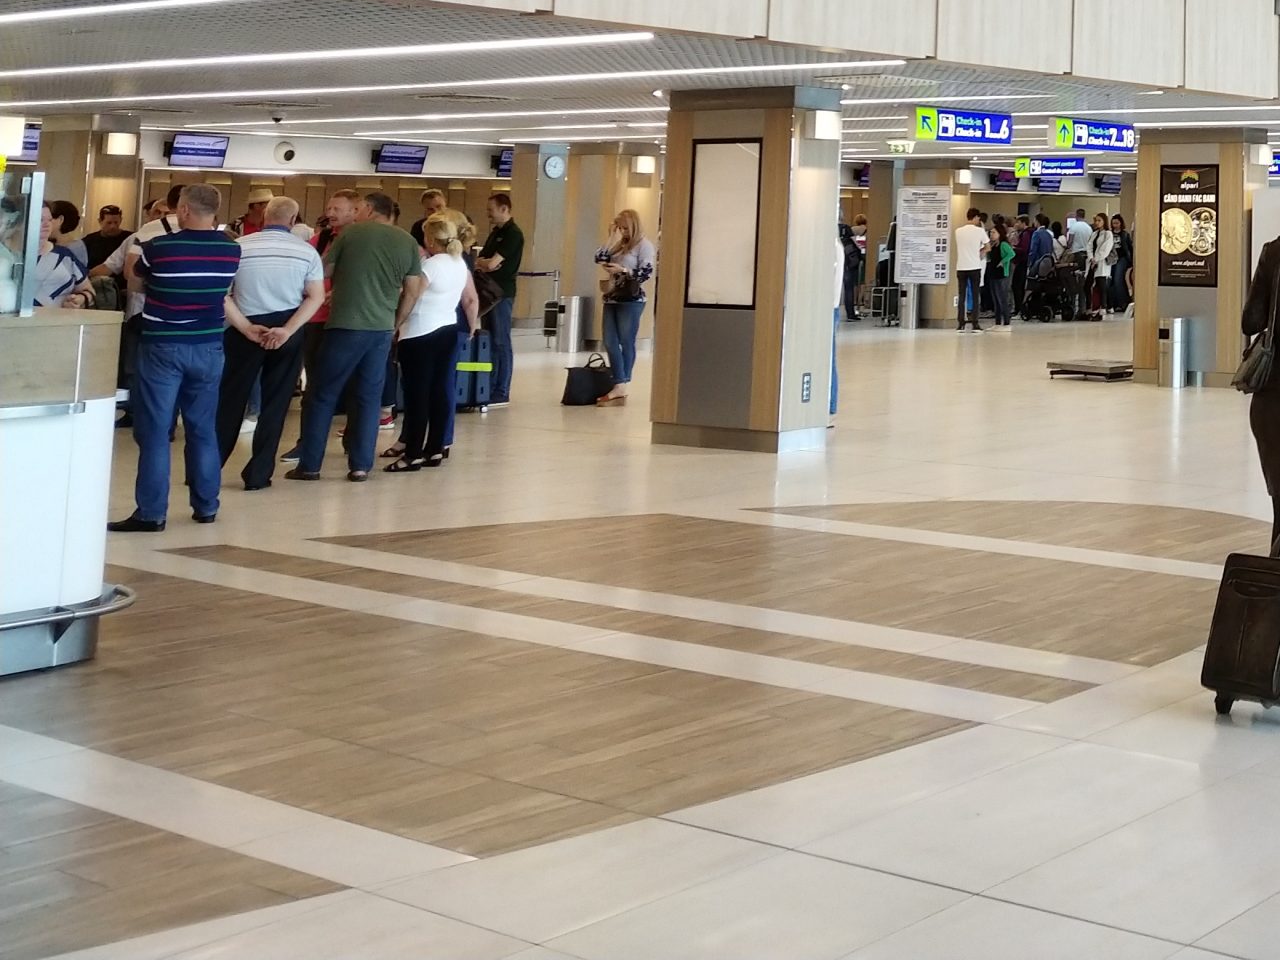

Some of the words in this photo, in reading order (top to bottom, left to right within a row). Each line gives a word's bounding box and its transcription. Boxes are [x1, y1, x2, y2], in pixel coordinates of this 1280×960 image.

[956, 115, 983, 126] Check-in
[956, 127, 983, 138] Check-in
[1089, 126, 1110, 136] Check-in
[1088, 136, 1110, 146] Check-in
[1180, 181, 1199, 191] alpari
[1192, 194, 1202, 203] FAC
